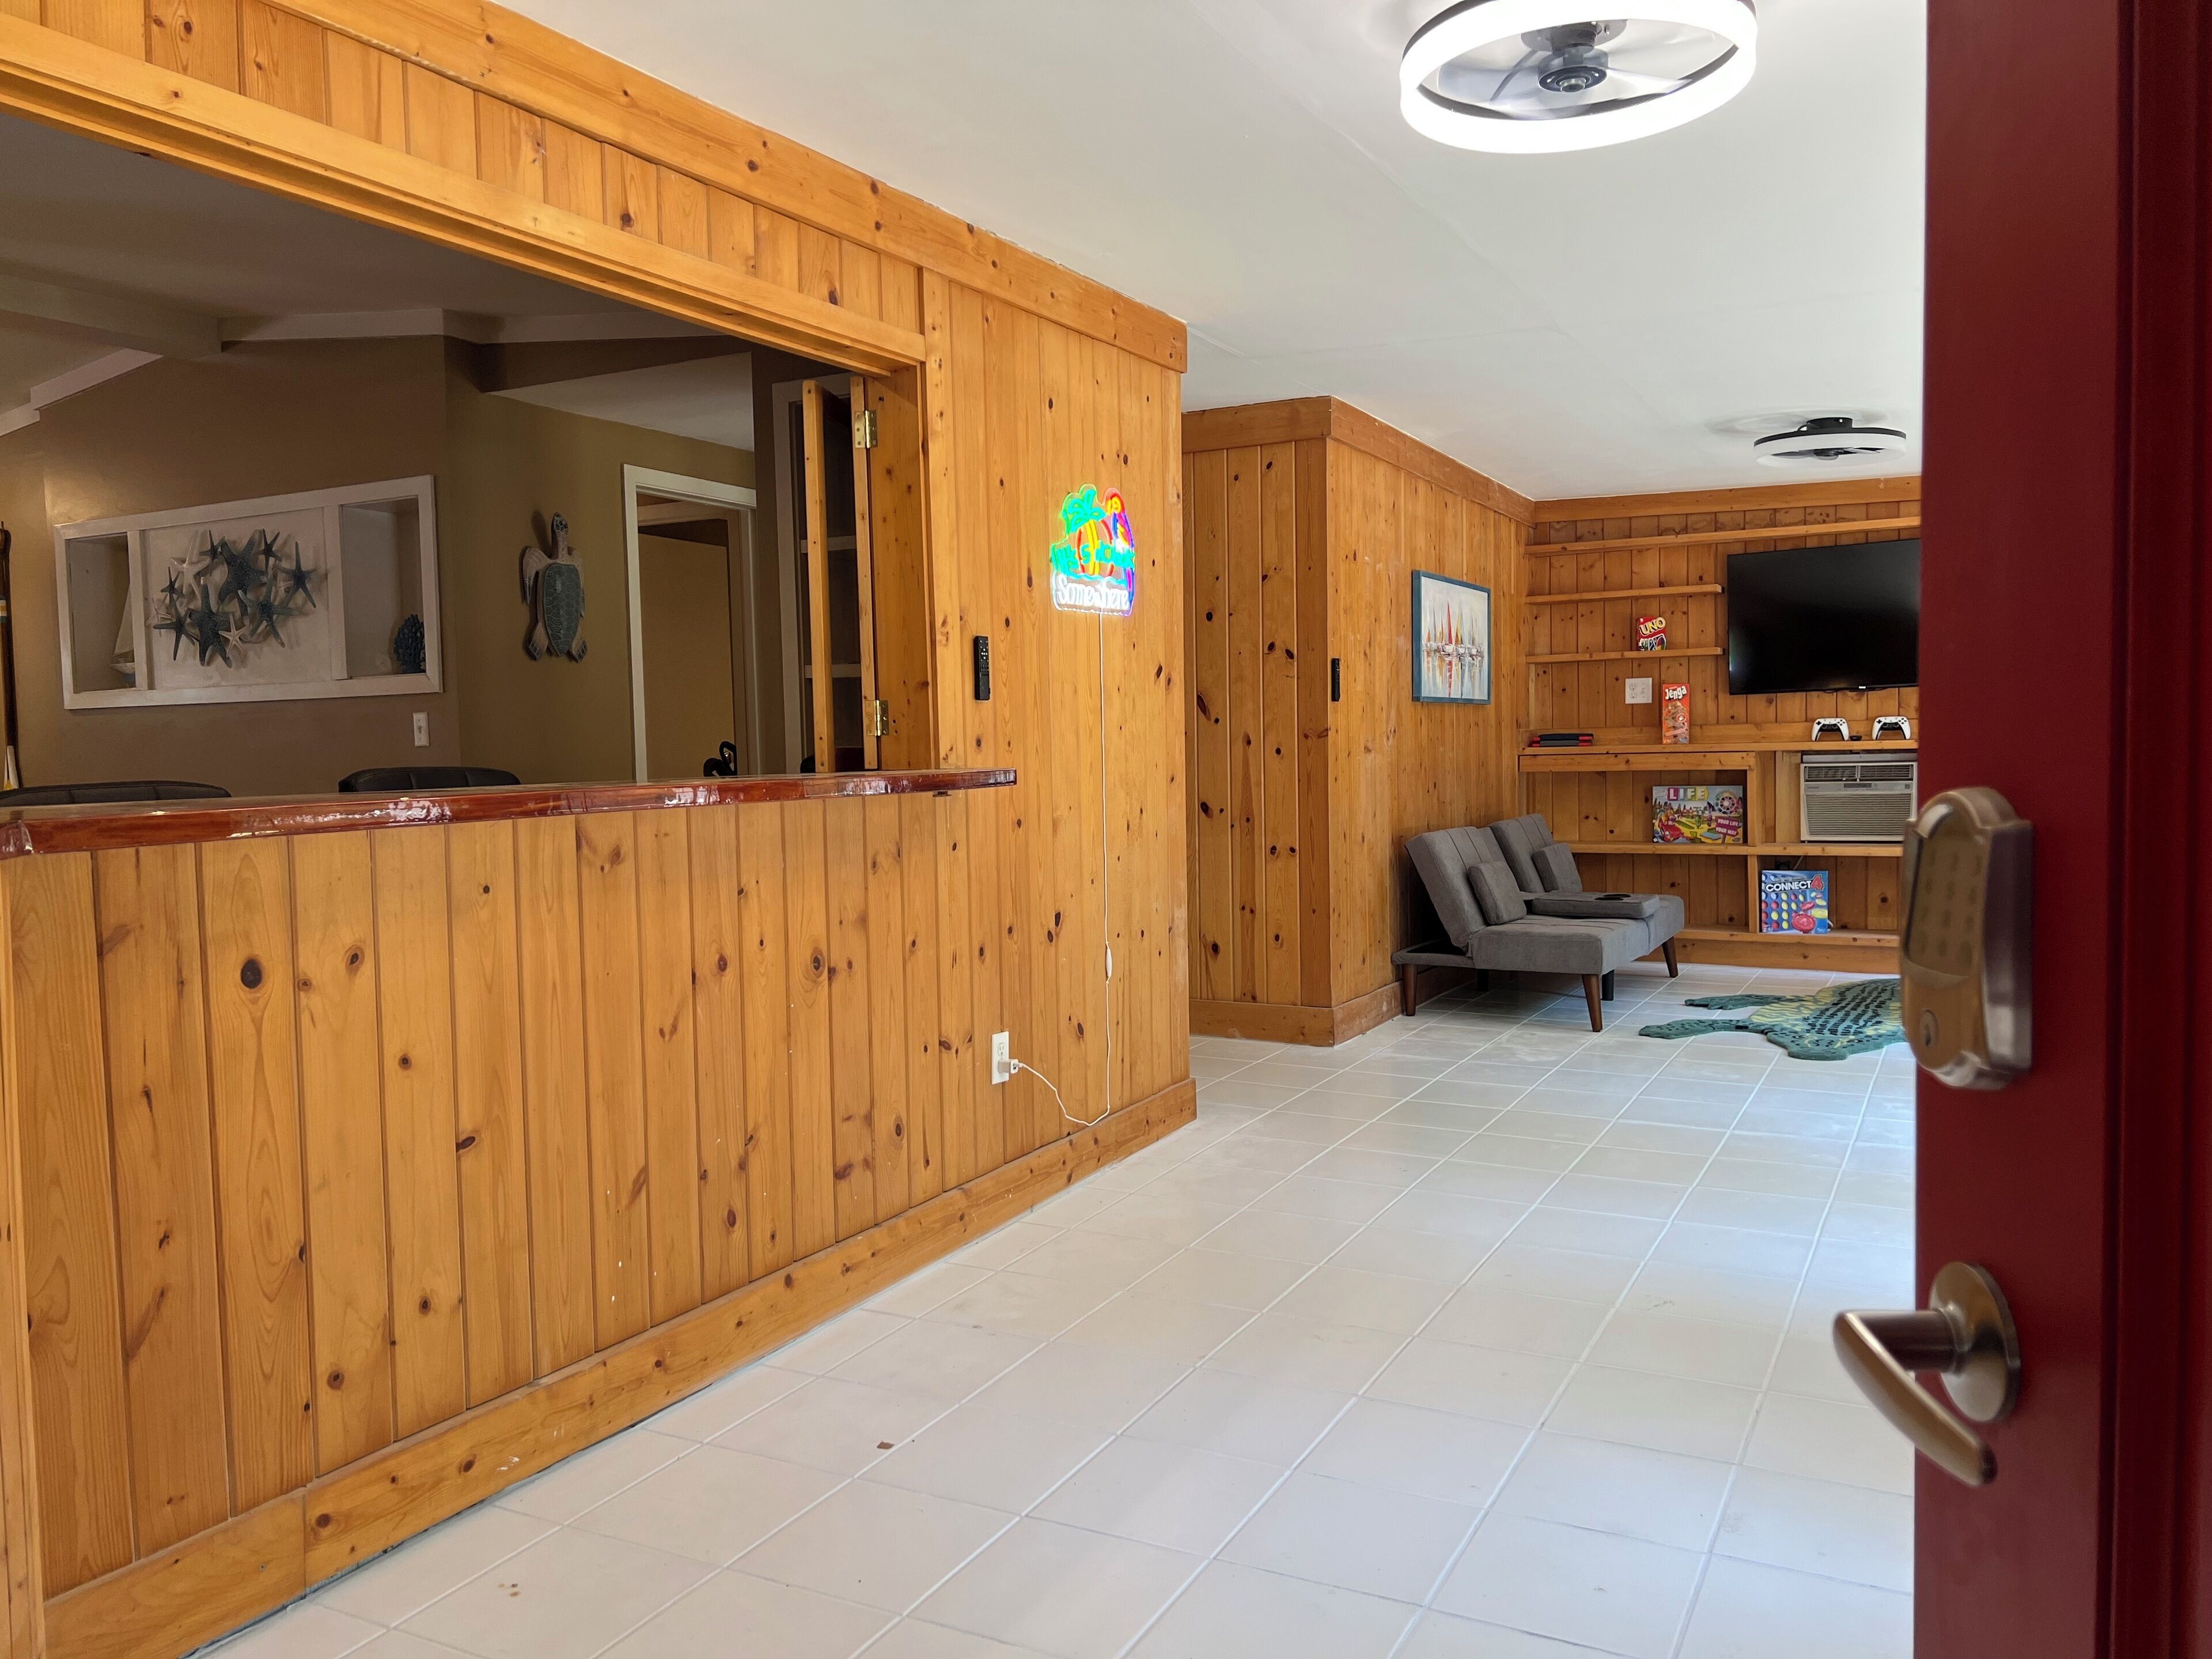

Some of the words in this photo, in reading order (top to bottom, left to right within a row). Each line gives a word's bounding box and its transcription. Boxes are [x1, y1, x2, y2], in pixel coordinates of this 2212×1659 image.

[1639, 617, 1666, 636] UNO
[1665, 685, 1687, 700] Jenga
[1669, 787, 1706, 800] LIFE
[1766, 880, 1812, 892] CONNECT
[1811, 874, 1824, 891] 4
